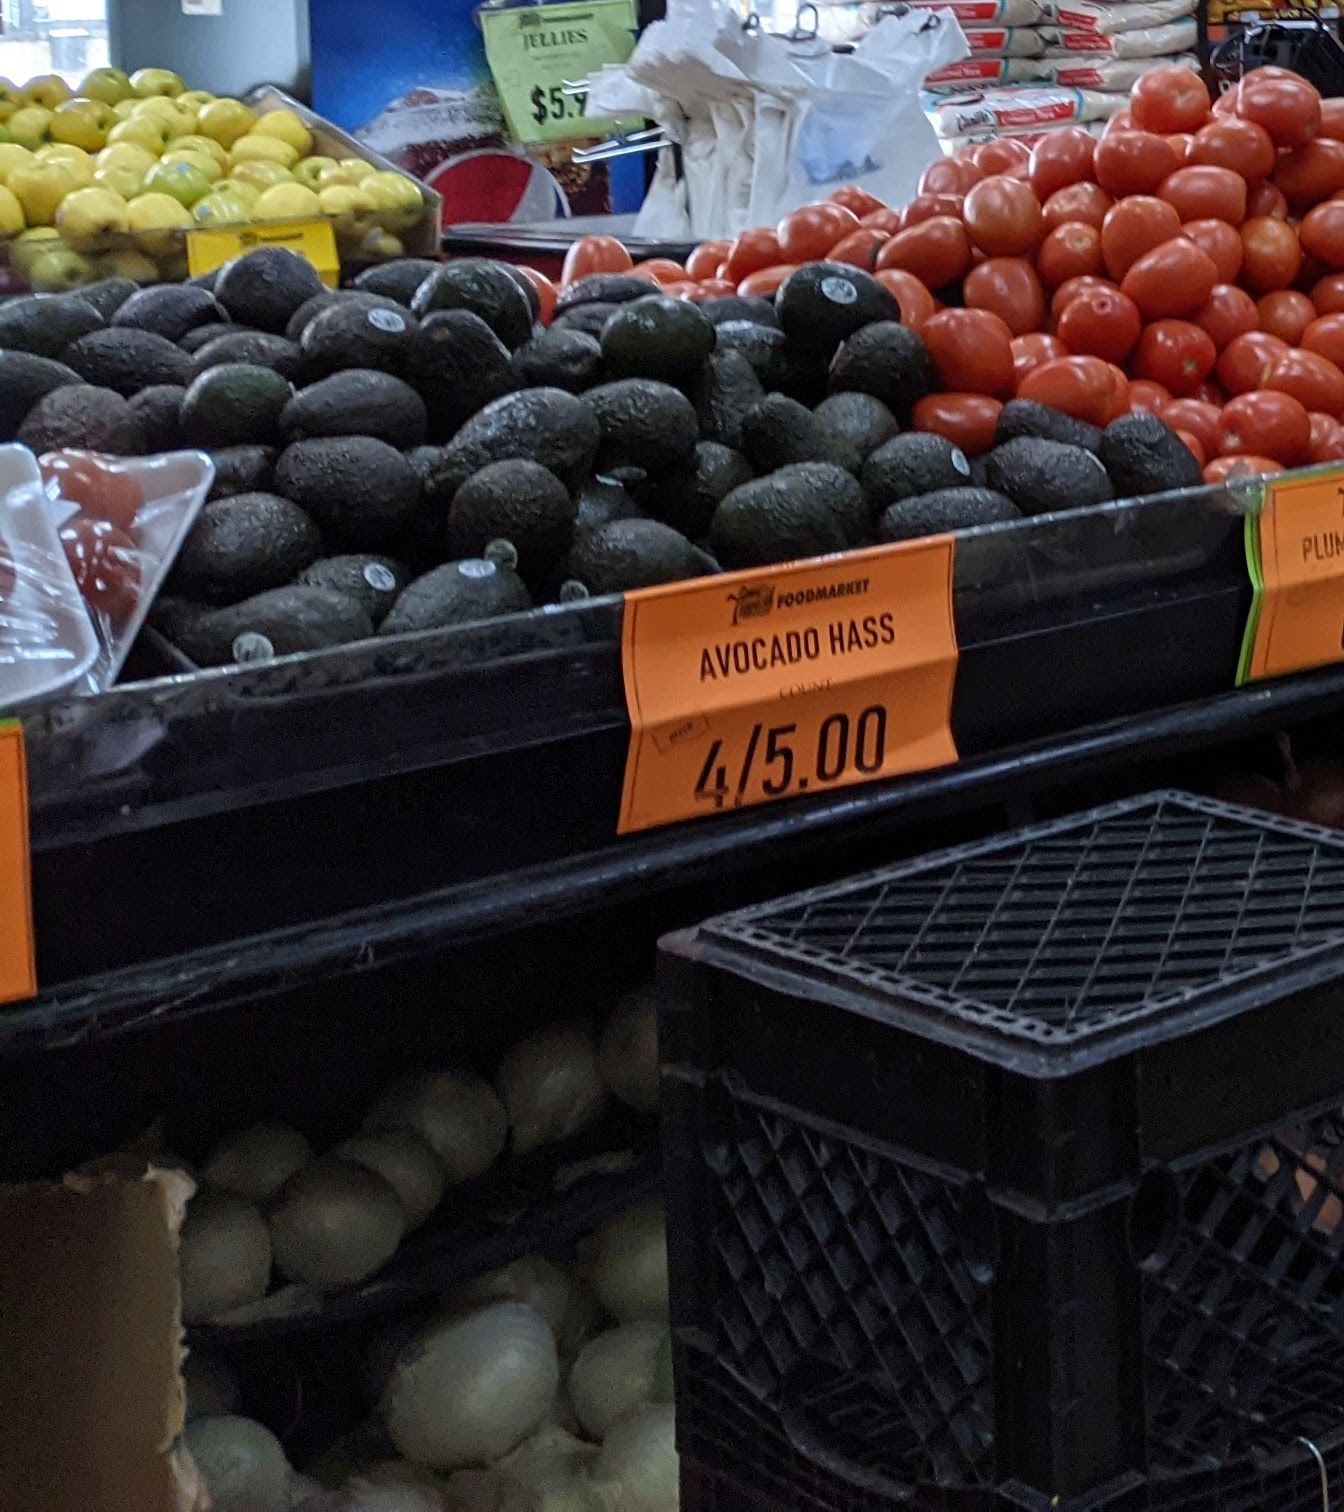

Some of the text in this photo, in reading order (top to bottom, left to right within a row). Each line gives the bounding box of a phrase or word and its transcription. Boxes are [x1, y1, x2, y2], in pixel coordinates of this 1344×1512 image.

[523, 28, 589, 50] JELLIES
[777, 578, 870, 609] FOODMARKET
[700, 612, 896, 682] AVOCADO HASS
[694, 704, 887, 809] 4/5.00
